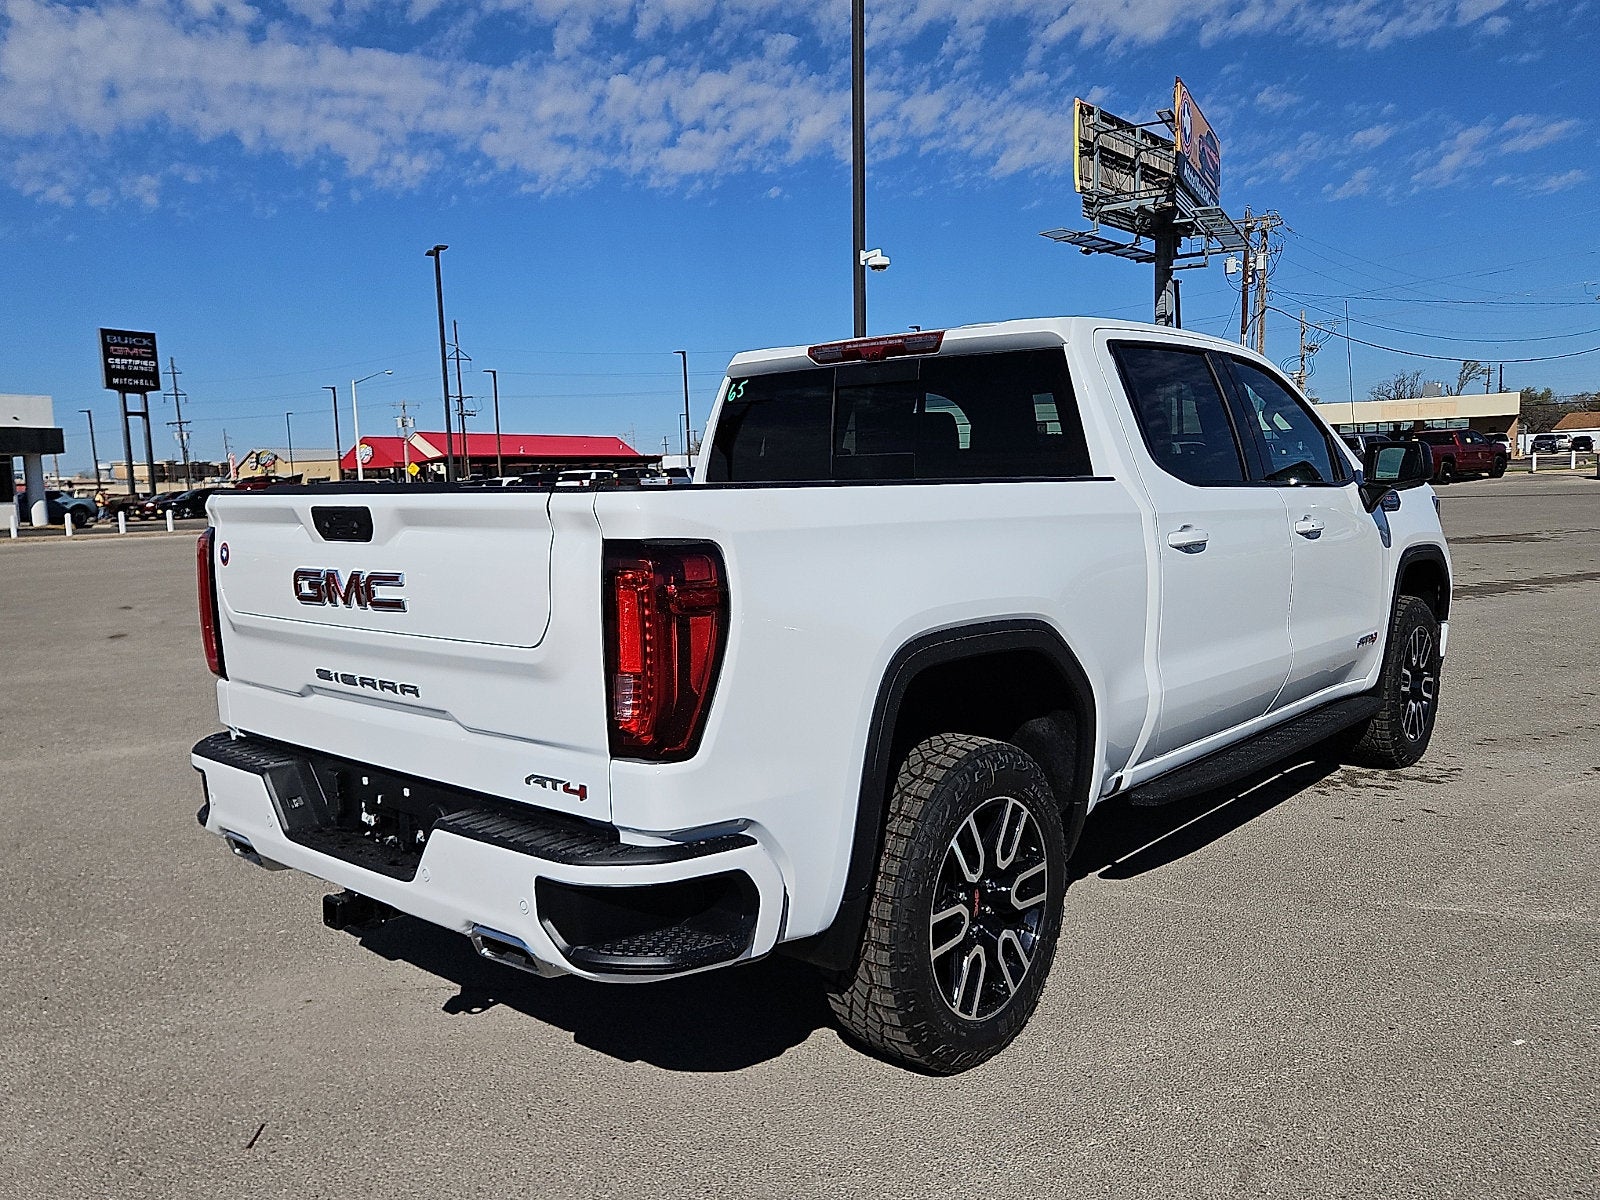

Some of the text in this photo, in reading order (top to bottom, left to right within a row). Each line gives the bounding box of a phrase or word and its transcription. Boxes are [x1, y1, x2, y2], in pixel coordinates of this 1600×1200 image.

[106, 335, 152, 346] BUICK
[110, 346, 152, 357] GMC
[107, 357, 156, 367] CERTIFIED
[112, 377, 156, 387] MITCHELL
[728, 379, 748, 401] 65
[293, 567, 408, 613] GMC
[315, 668, 420, 698] SIERRA
[524, 773, 587, 802] AT4
